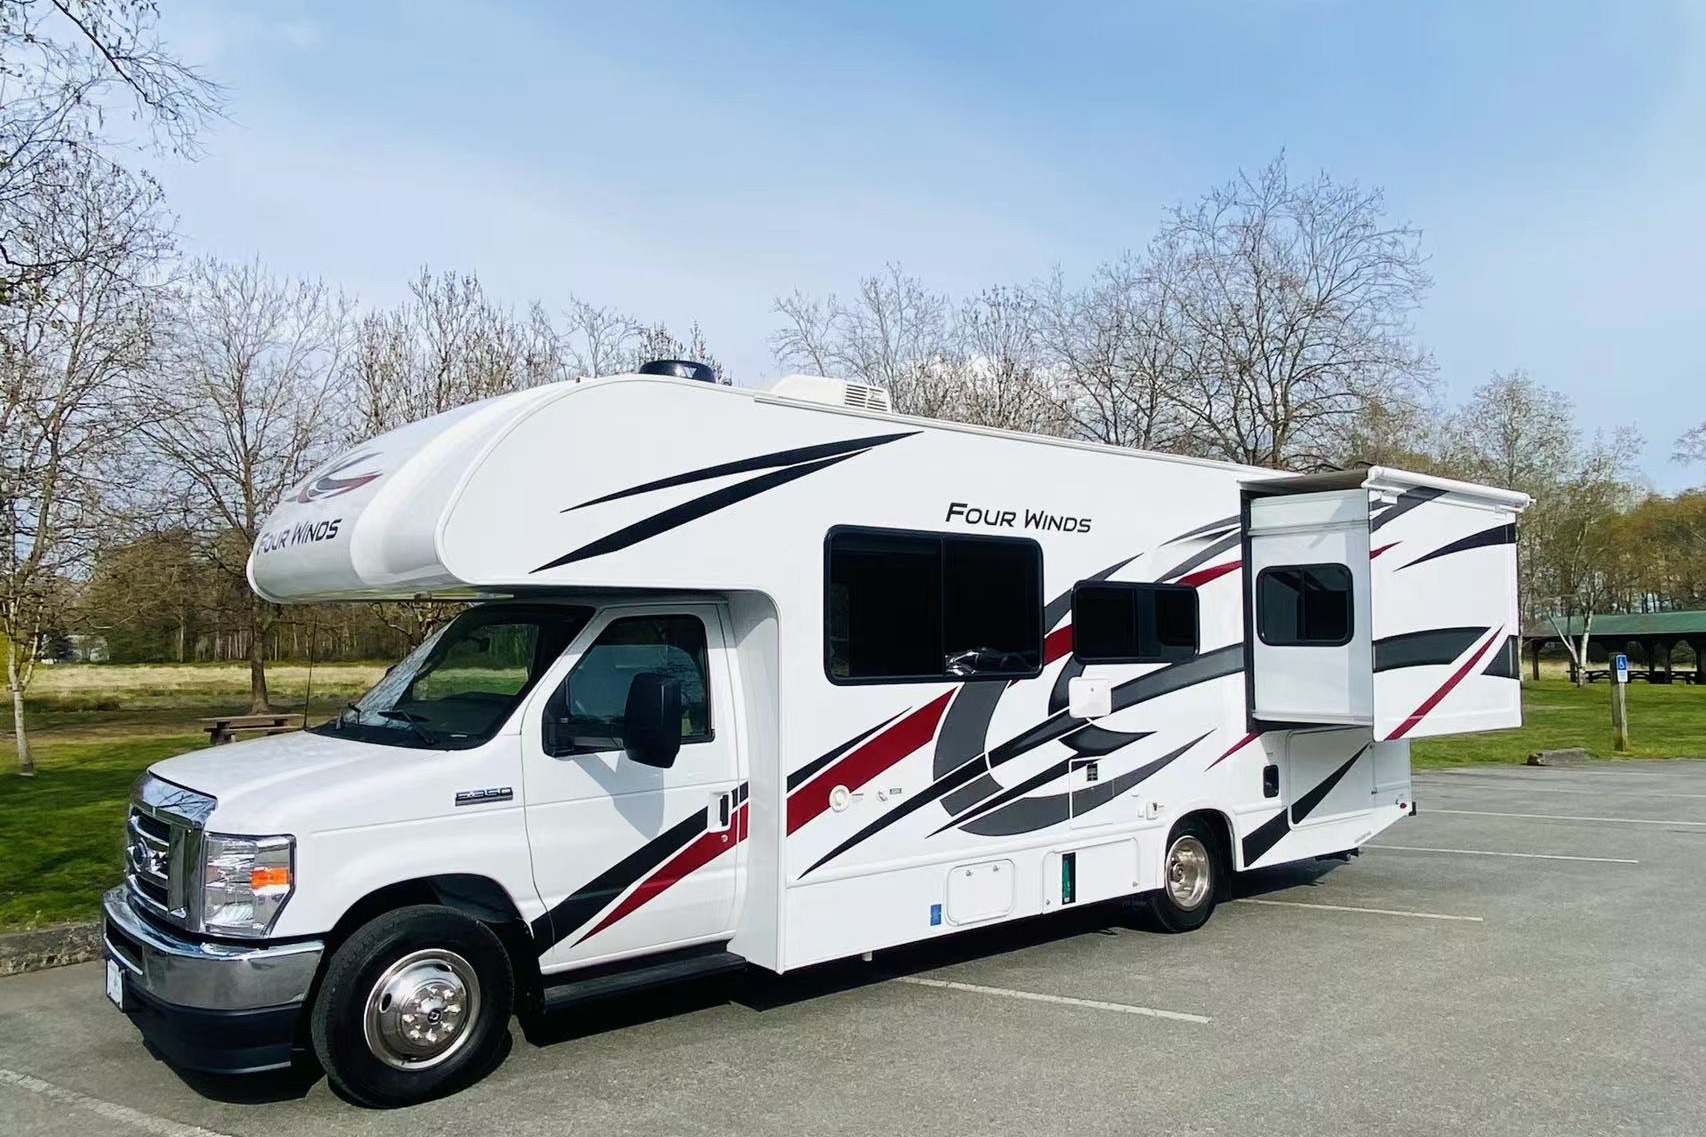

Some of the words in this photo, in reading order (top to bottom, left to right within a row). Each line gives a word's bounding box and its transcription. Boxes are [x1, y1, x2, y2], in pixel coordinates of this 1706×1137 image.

[945, 502, 1017, 528] FOUR
[1024, 509, 1092, 533] WINDS
[256, 529, 290, 555] FOUR
[291, 519, 342, 546] WINDS
